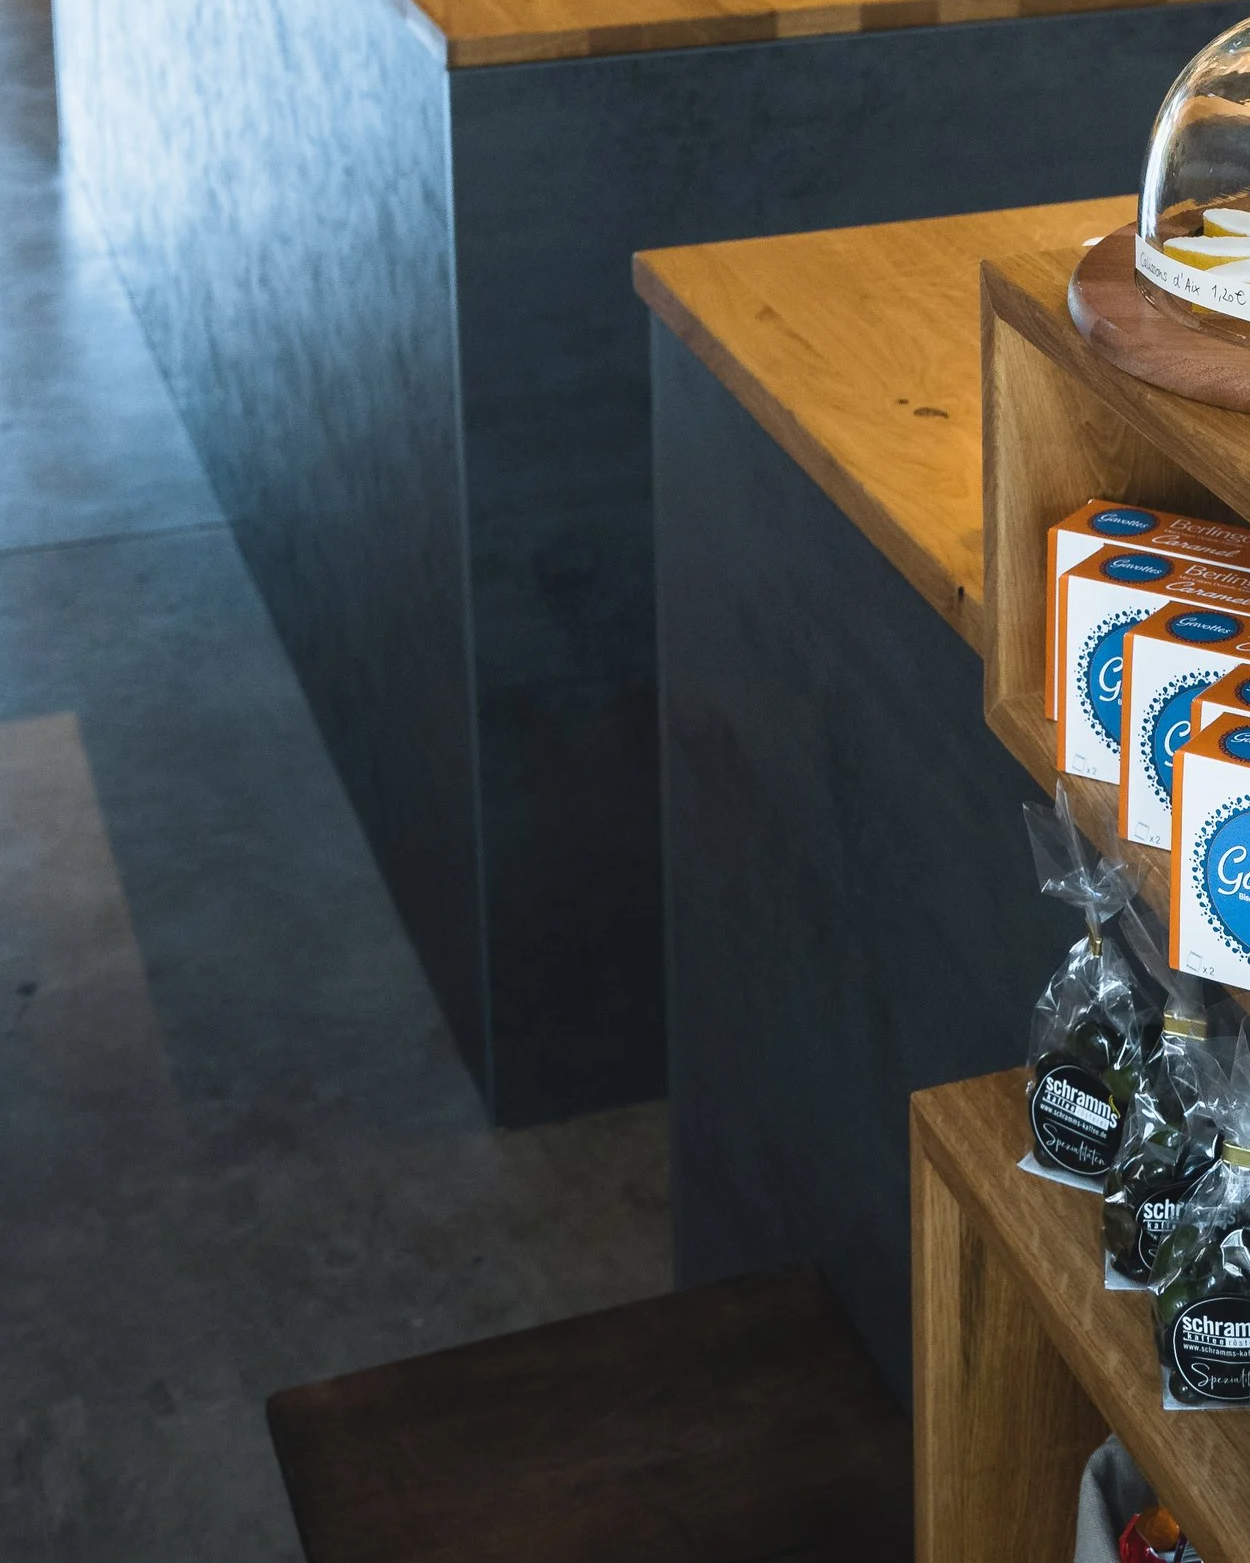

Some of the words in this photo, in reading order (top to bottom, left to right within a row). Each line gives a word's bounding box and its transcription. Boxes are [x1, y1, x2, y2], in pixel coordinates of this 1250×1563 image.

[1097, 513, 1149, 529] Gavottes
[1152, 534, 1241, 558] Caramel
[1110, 558, 1162, 575] Gavottes
[1175, 617, 1232, 635] Gavottes
[1045, 1076, 1118, 1129] schramms
[1039, 1103, 1107, 1139] www.schramms-kaffee.de
